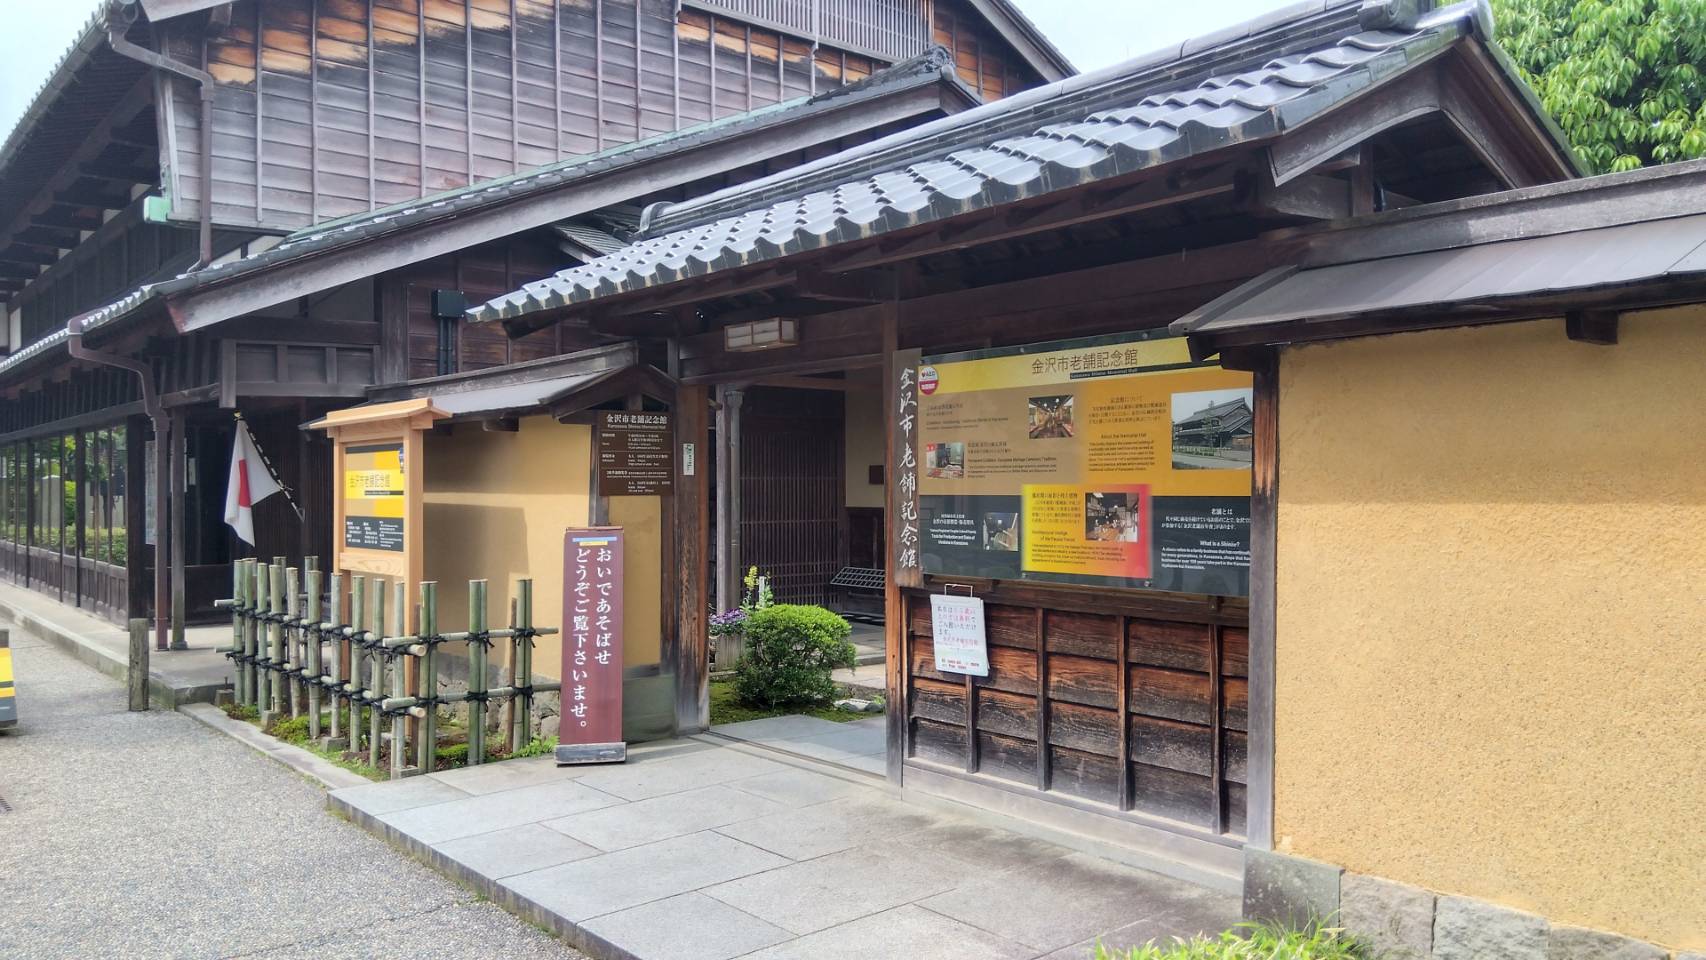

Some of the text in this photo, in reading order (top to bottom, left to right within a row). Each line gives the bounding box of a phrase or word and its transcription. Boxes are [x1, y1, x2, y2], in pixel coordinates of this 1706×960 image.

[607, 413, 667, 424] 金沢市老舗記念館
[1032, 349, 1137, 375] 金沢市老舗記念館
[899, 367, 917, 569] 金沢市老舗記念館
[570, 548, 591, 727] どうぞご覧下さいませ。
[595, 548, 612, 665] おいであそばせ
